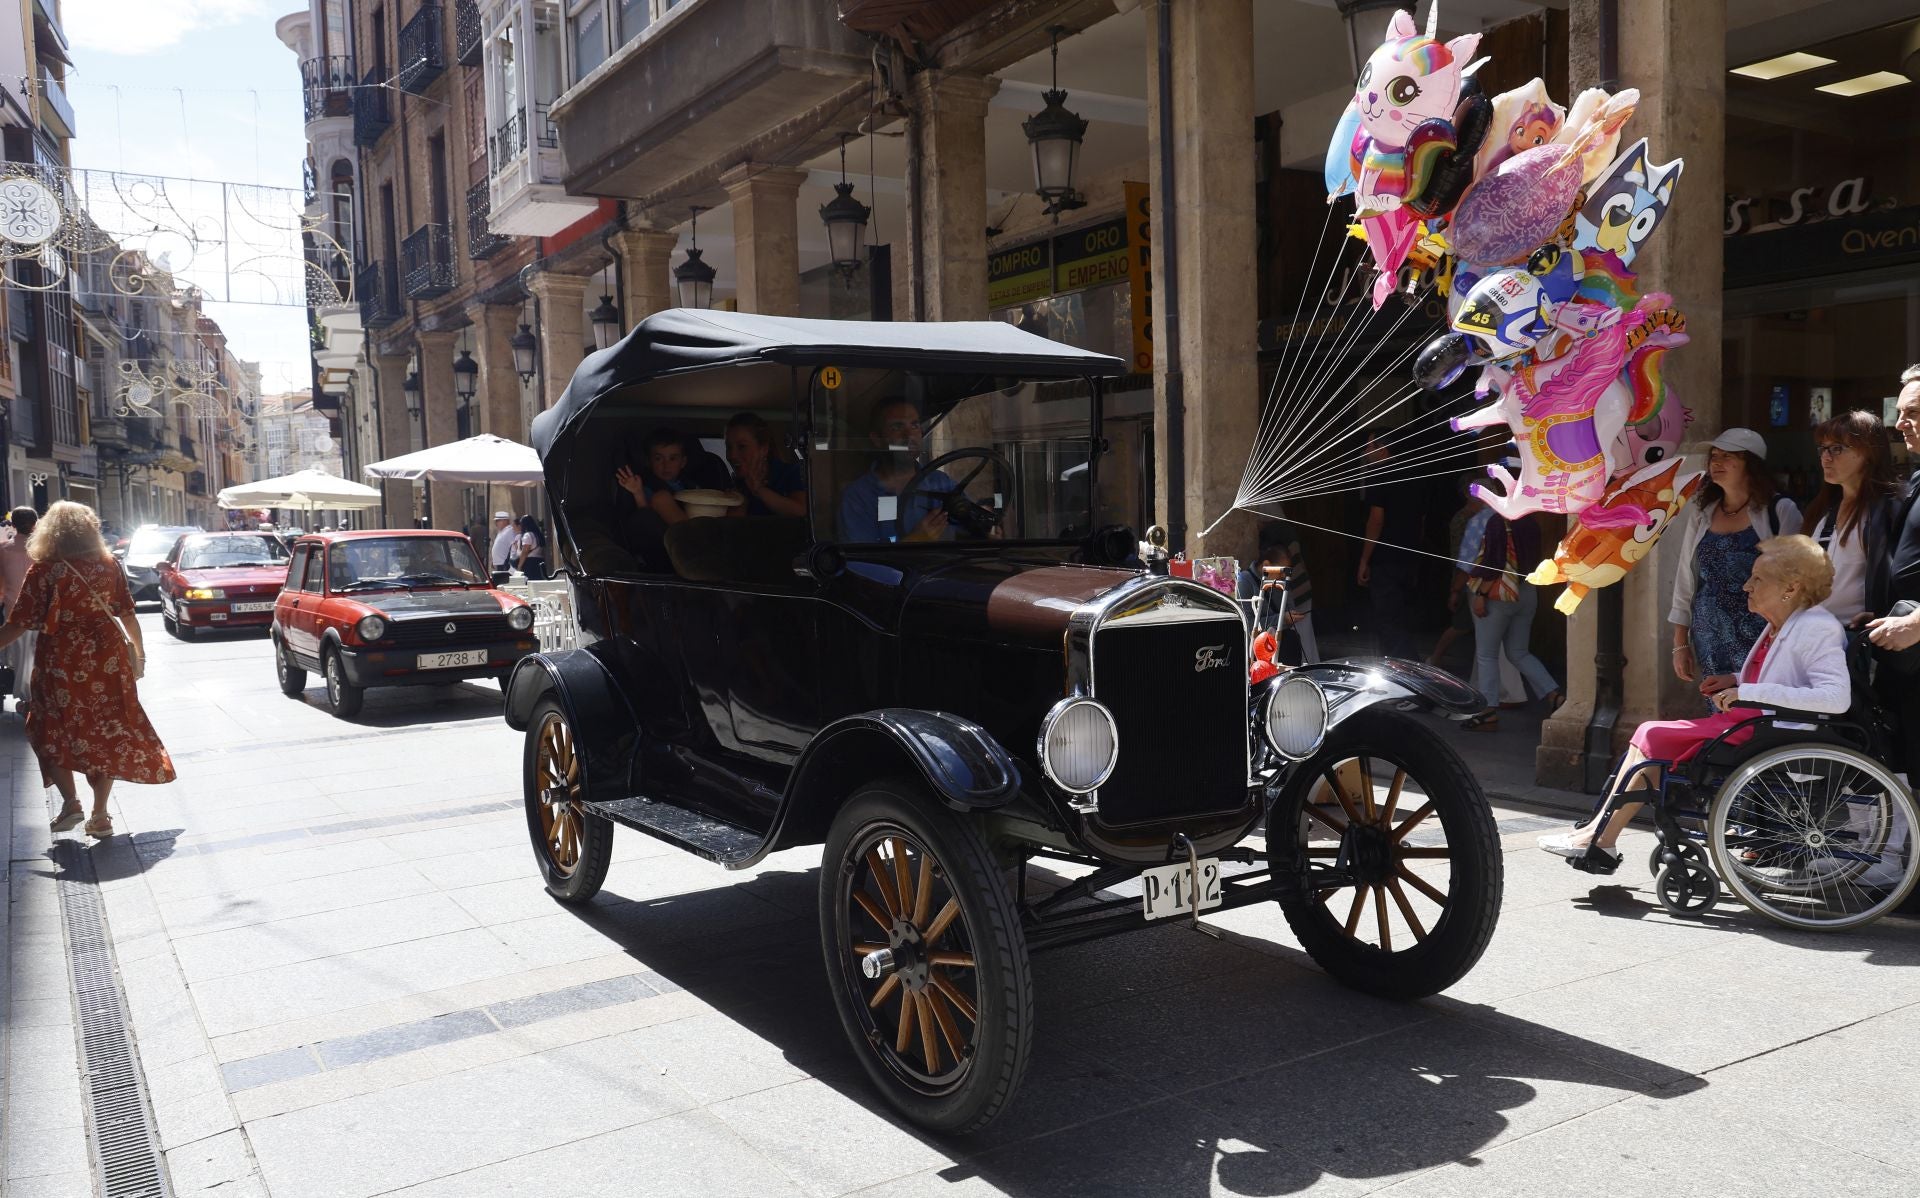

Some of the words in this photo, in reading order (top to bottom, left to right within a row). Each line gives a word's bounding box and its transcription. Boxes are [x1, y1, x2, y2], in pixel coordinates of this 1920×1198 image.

[1085, 226, 1120, 253] ORO
[1067, 255, 1129, 287] EMPEÑO
[1488, 287, 1509, 307] GRABO
[438, 652, 469, 667] 2738
[1194, 643, 1232, 673] Ford
